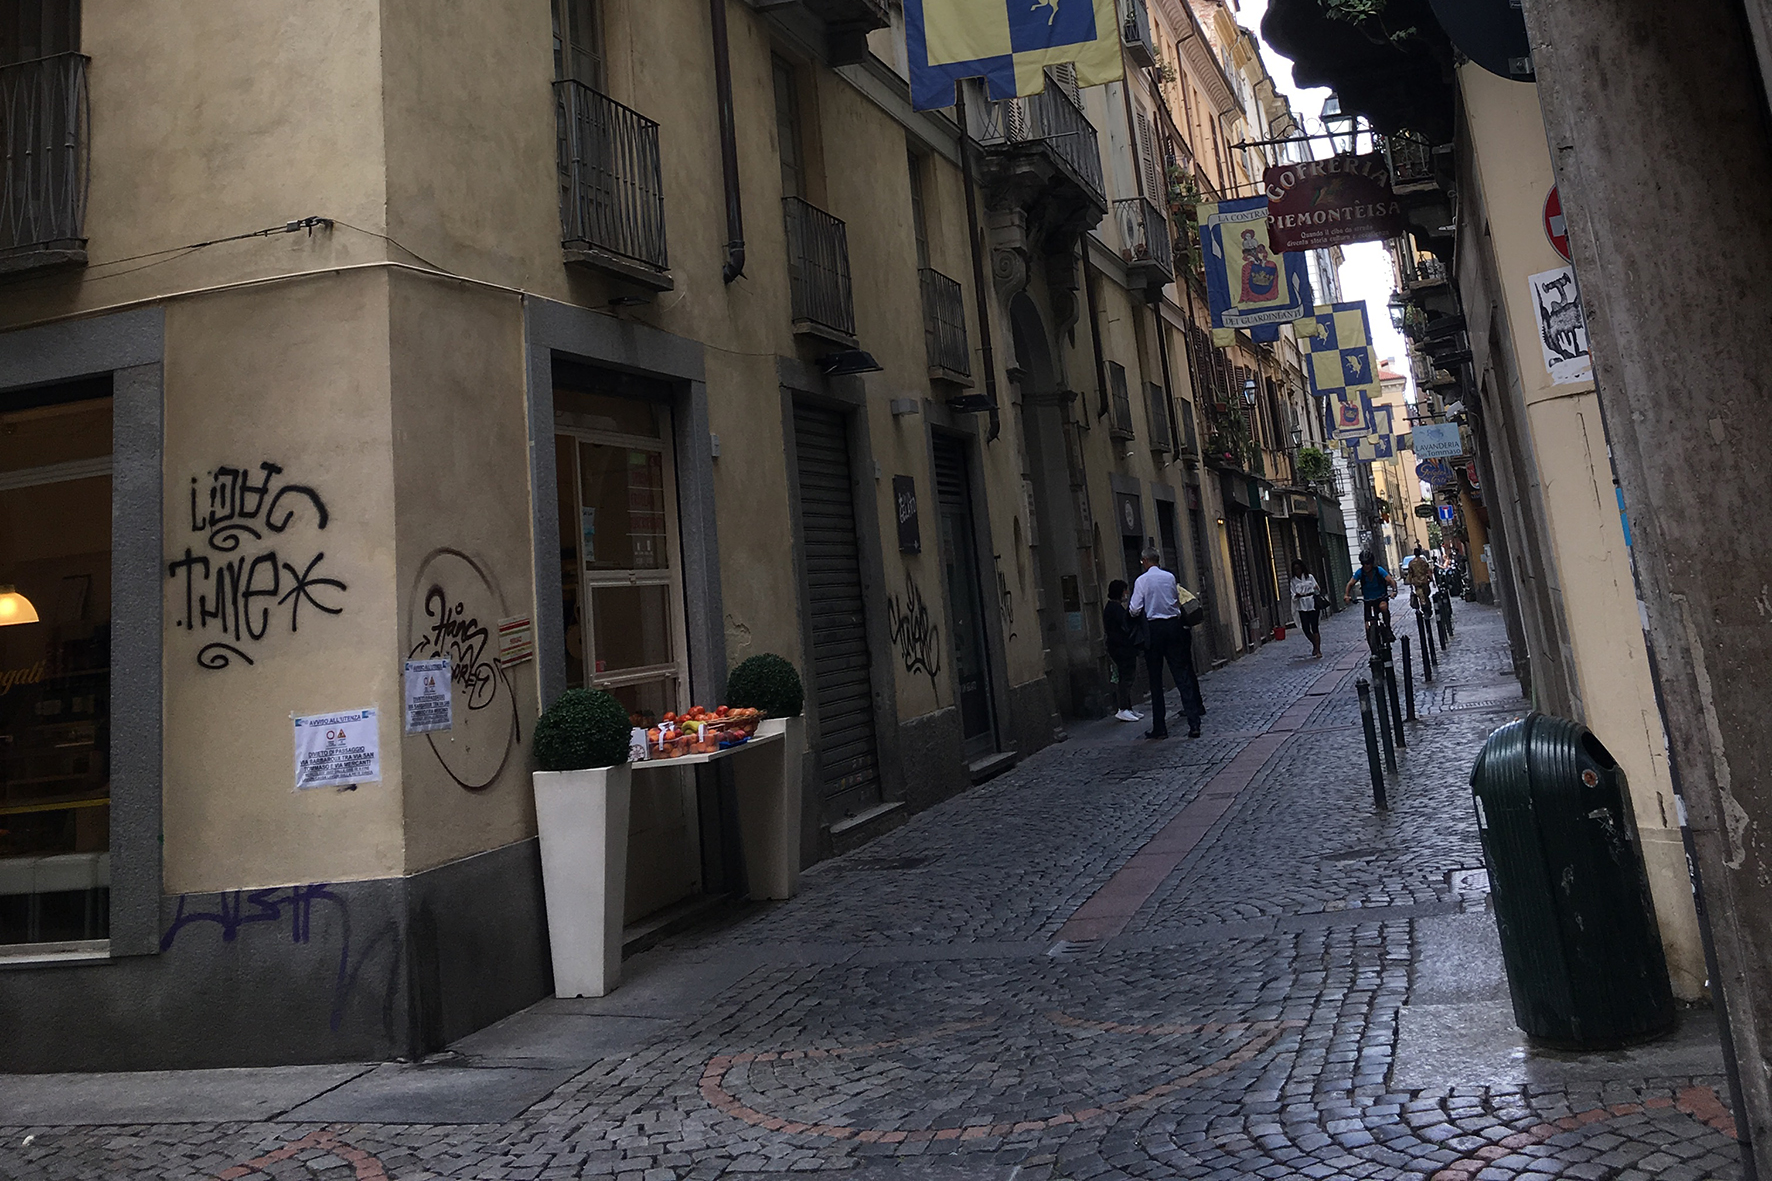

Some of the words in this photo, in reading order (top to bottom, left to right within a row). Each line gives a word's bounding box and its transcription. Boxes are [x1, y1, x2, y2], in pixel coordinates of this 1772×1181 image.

[1266, 158, 1389, 200] GOFRERIA
[1218, 214, 1229, 222] LA
[1301, 230, 1324, 239] Quando
[1225, 317, 1240, 326] DEI
[1416, 441, 1460, 452] LAVANDERIA
[1427, 448, 1461, 456] Tommaso
[309, 718, 328, 726] AVVISO
